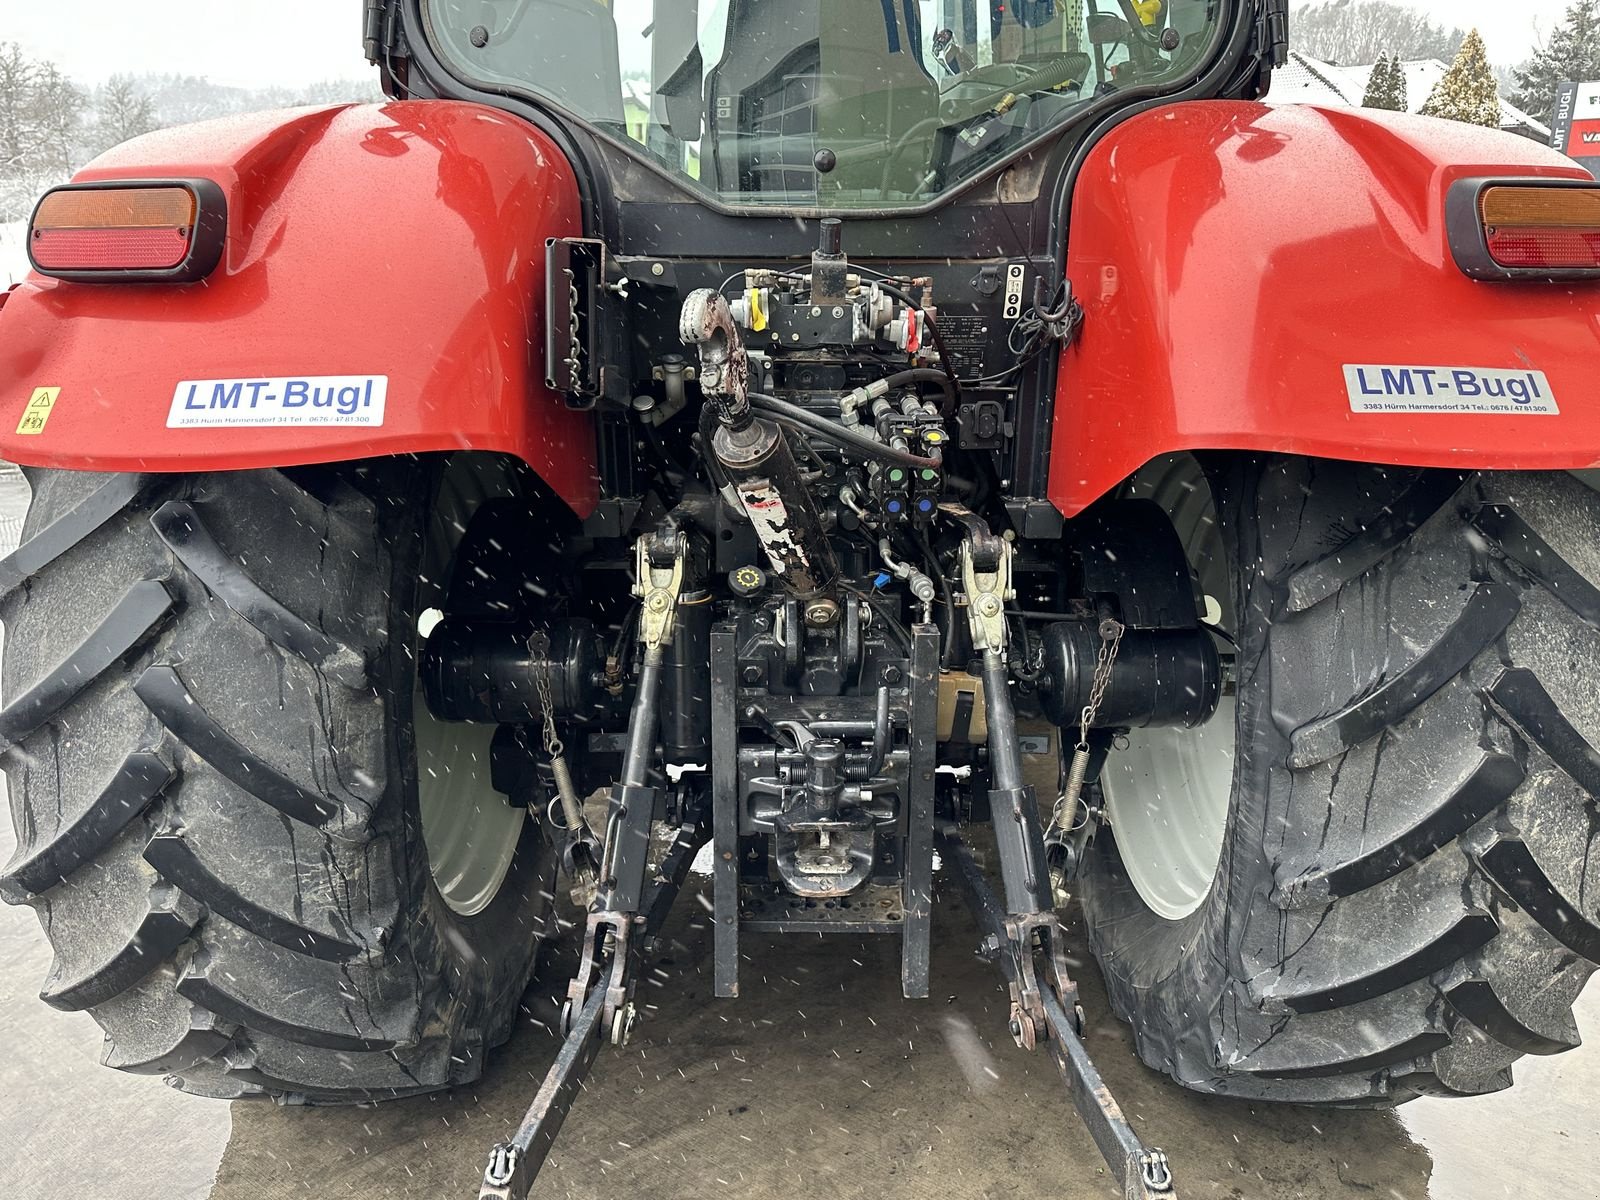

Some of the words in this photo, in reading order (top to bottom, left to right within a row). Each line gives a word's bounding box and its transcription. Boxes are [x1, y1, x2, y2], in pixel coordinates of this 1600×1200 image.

[1558, 89, 1572, 119] BUGL
[1553, 128, 1565, 150] LMT
[184, 379, 373, 415] LMT-Bugl
[1356, 368, 1541, 404] LMT-Bugl
